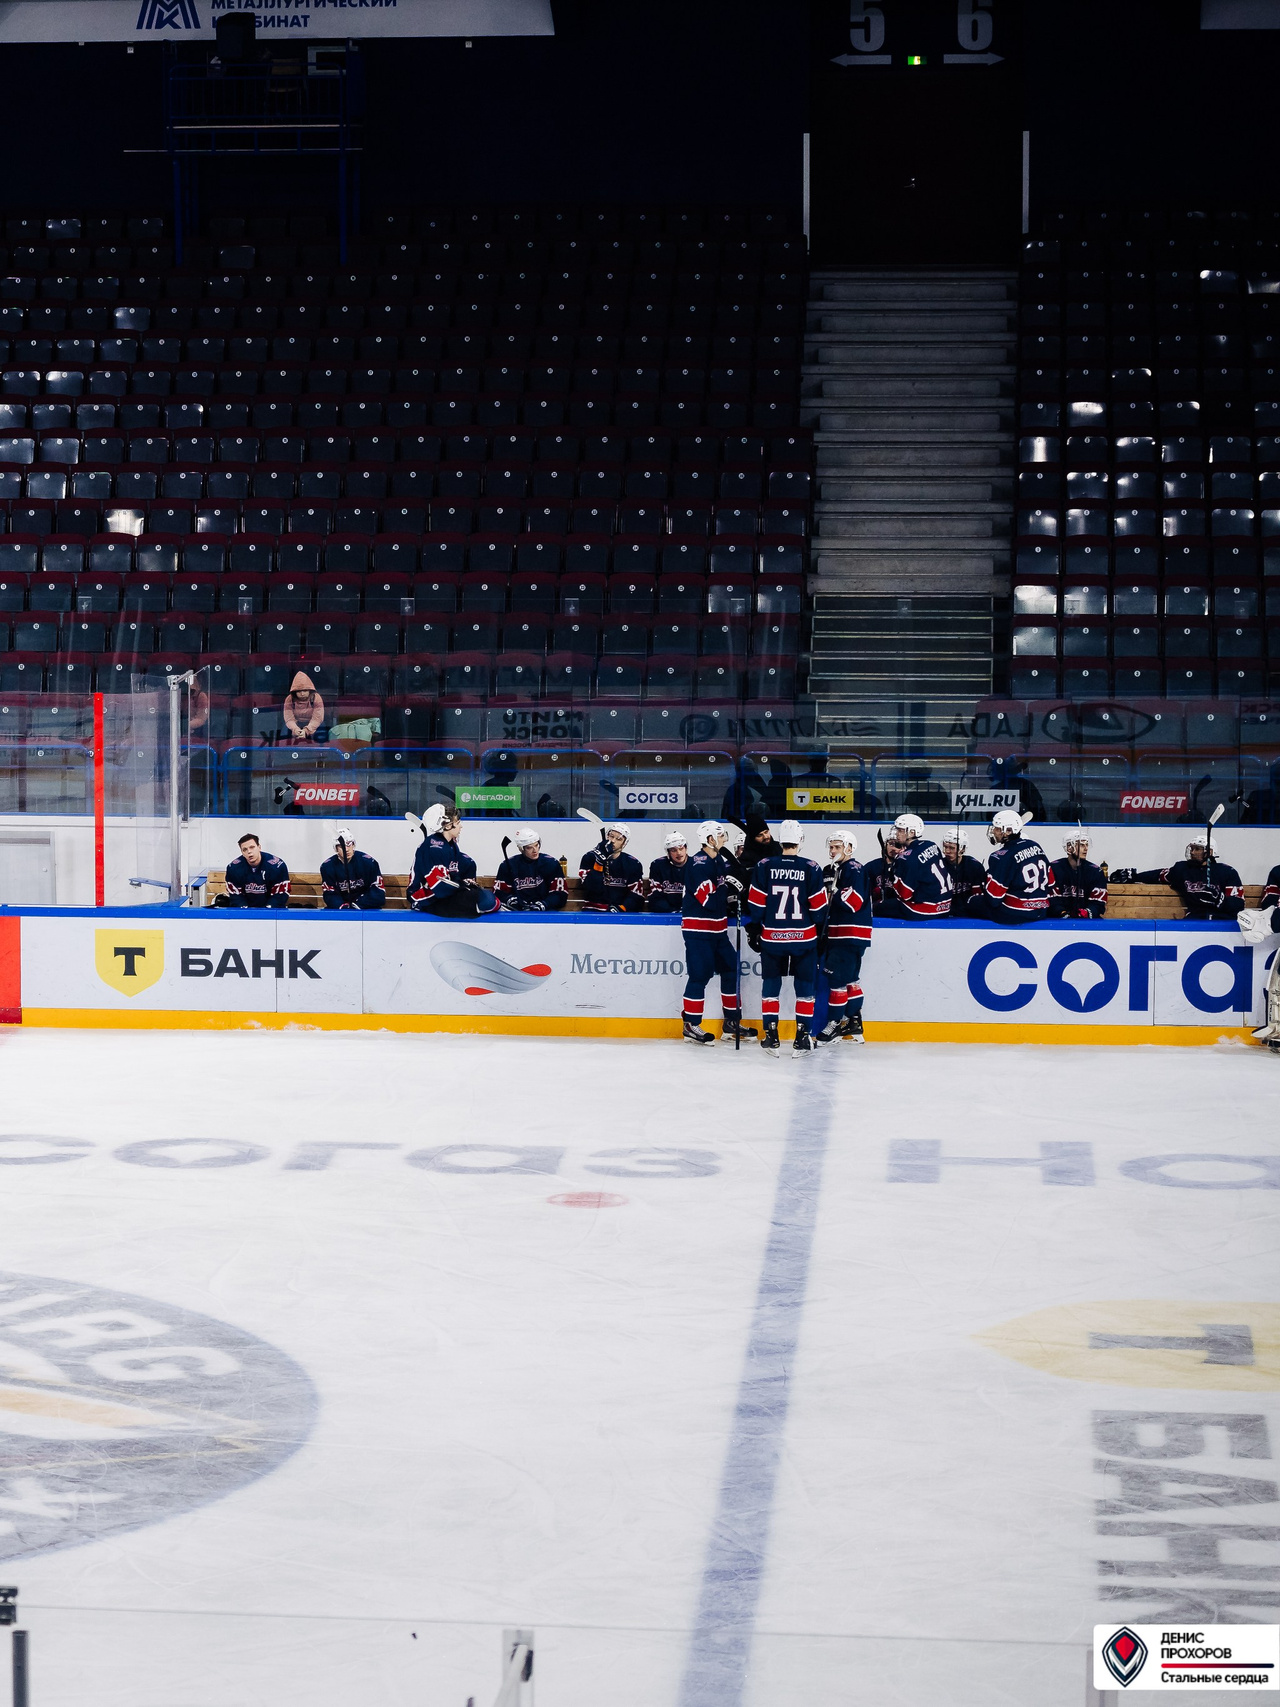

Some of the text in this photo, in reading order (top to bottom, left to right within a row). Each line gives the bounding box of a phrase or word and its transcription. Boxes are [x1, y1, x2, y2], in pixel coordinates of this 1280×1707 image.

[212, 15, 310, 28] БИНАТ
[850, 0, 885, 52] 5
[957, 0, 993, 51] 6
[295, 787, 358, 802] FONBET
[813, 795, 847, 804] БАНК
[955, 793, 1017, 808] KHL.RU
[1121, 795, 1186, 809] FONBET
[770, 868, 805, 881] ТУРУСОВ
[772, 885, 803, 920] 71
[180, 947, 322, 979] БАНК
[571, 953, 762, 976] Металлоес
